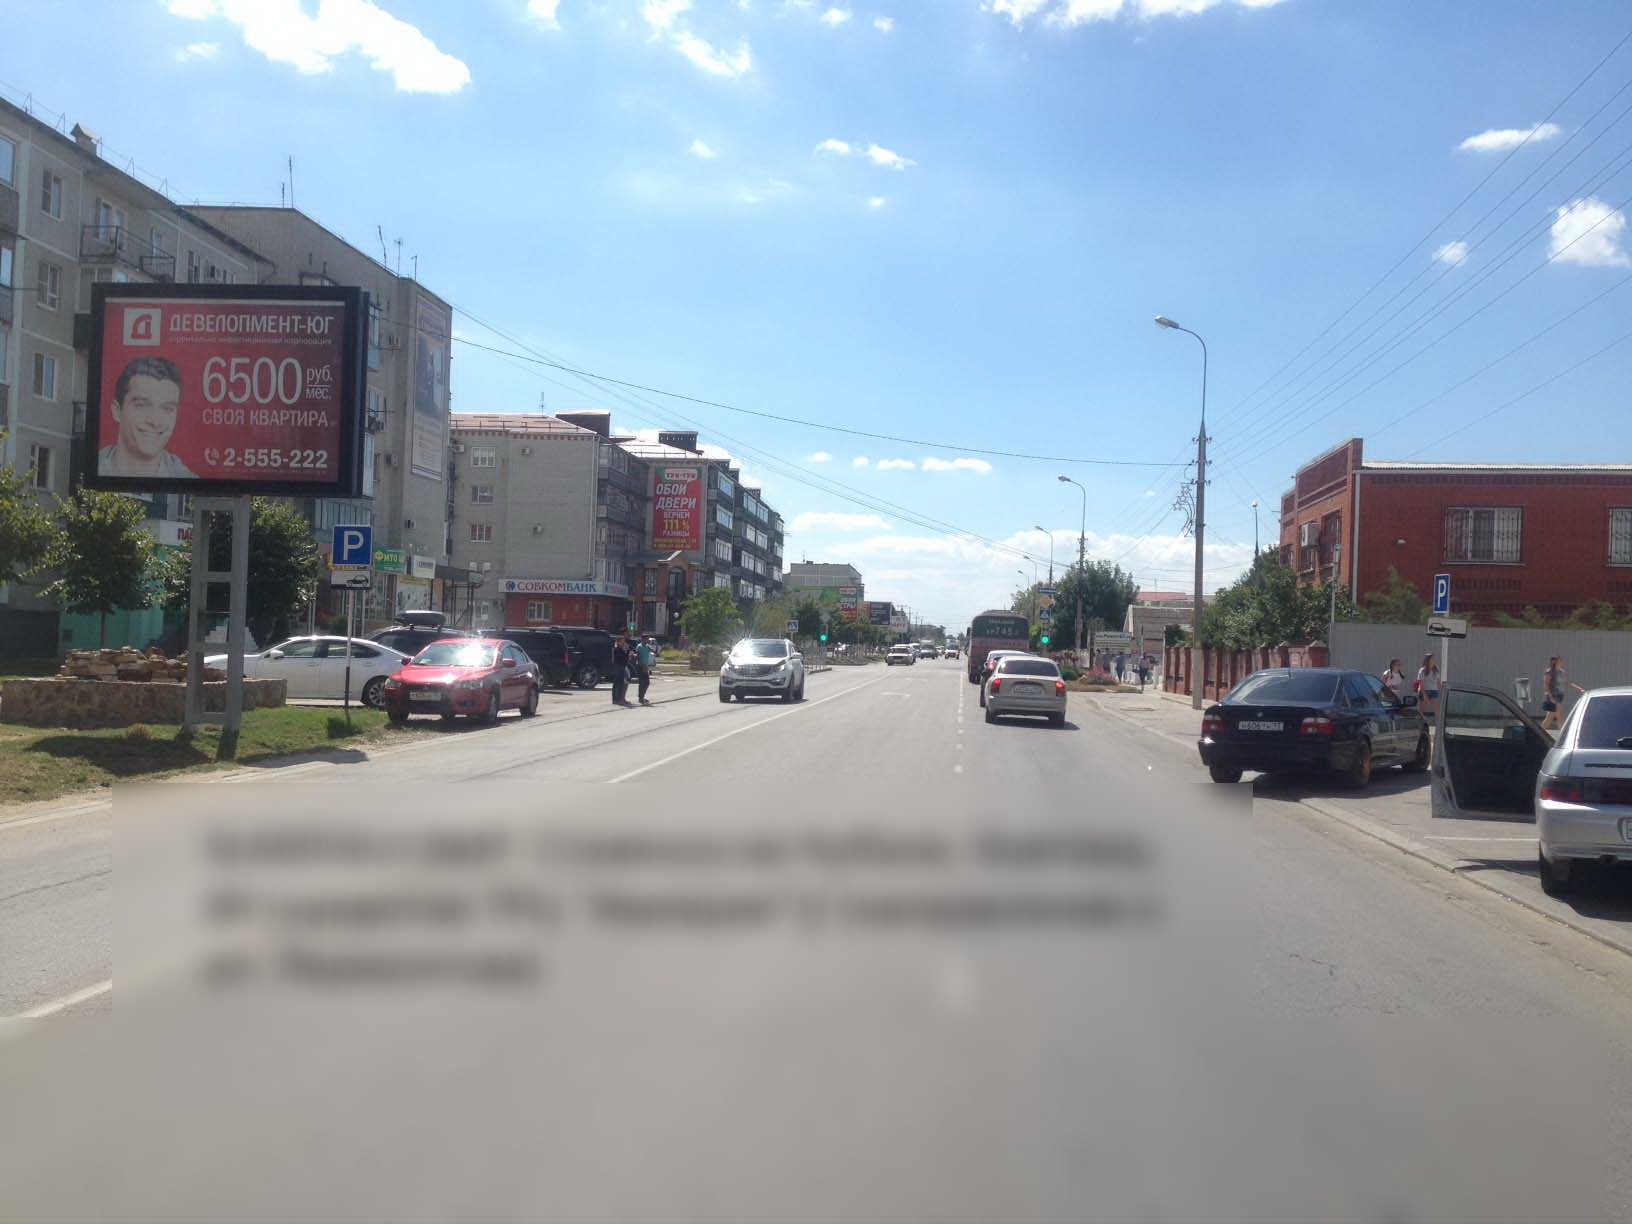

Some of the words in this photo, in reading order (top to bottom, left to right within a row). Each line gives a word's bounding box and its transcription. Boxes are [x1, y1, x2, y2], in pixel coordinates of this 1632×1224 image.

[169, 314, 335, 334] ДЕВЕЛОПМЕНТ-ЮГ
[203, 357, 302, 404] 6500
[306, 364, 333, 385] руб.
[305, 387, 332, 400] мес.
[202, 408, 245, 425] СВОЯ
[250, 409, 328, 427] КВАРТИРА
[223, 448, 328, 468] 2-555-222
[656, 498, 696, 510] ДВЕРИ
[343, 530, 364, 560] P
[517, 581, 597, 593] СОВКОМБАНК
[1438, 580, 1446, 608] P
